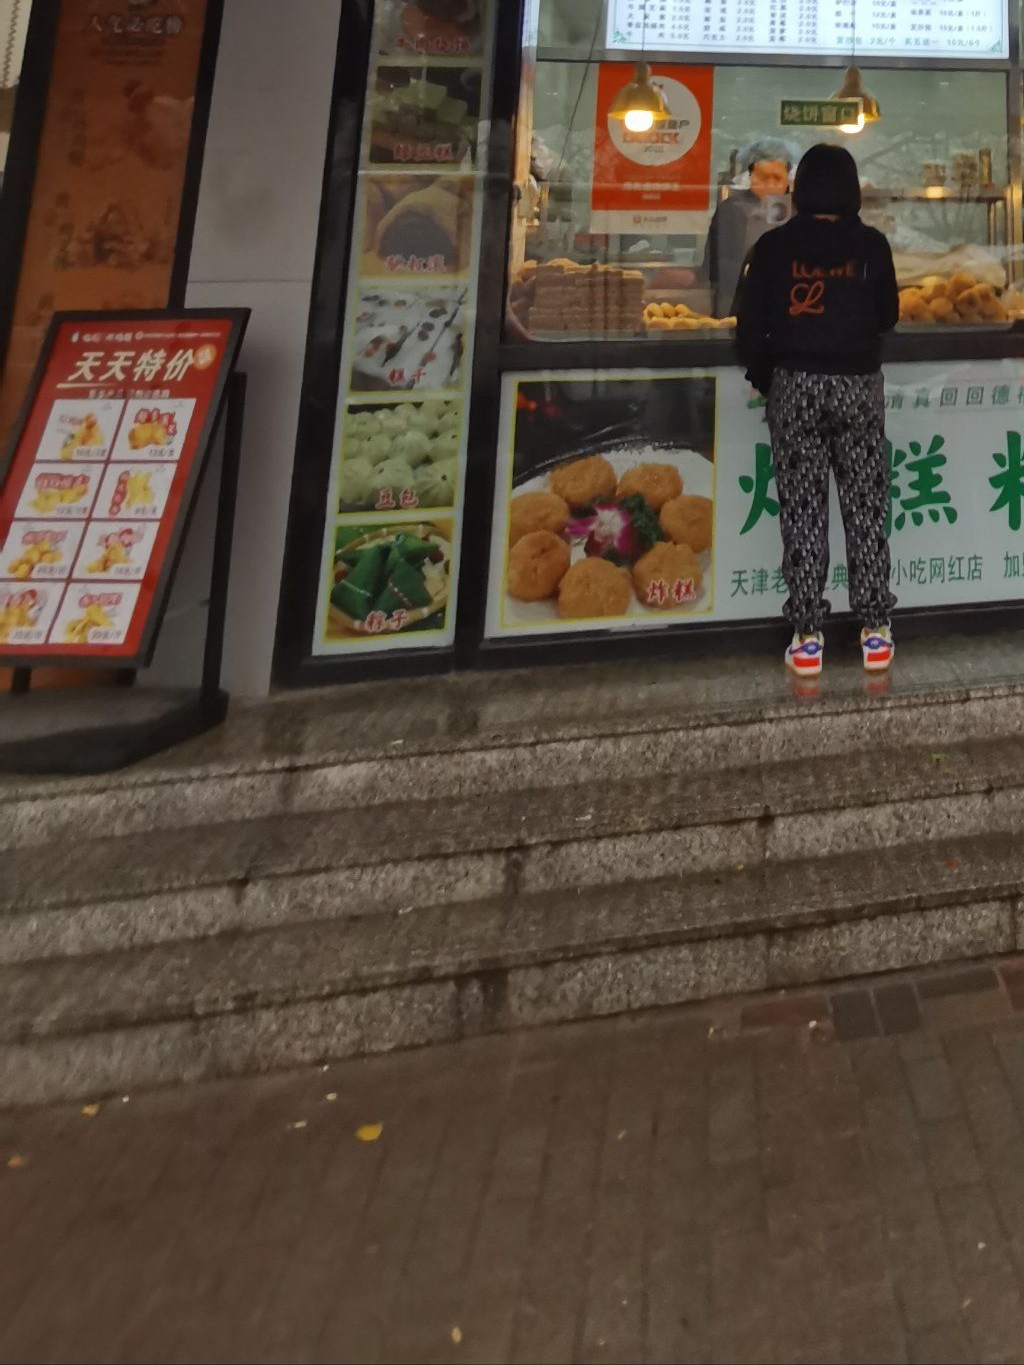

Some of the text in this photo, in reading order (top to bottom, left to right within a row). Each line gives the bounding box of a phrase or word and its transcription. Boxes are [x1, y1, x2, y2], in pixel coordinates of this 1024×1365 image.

[67, 349, 194, 382] 天天特价
[647, 579, 698, 604] 炸糕
